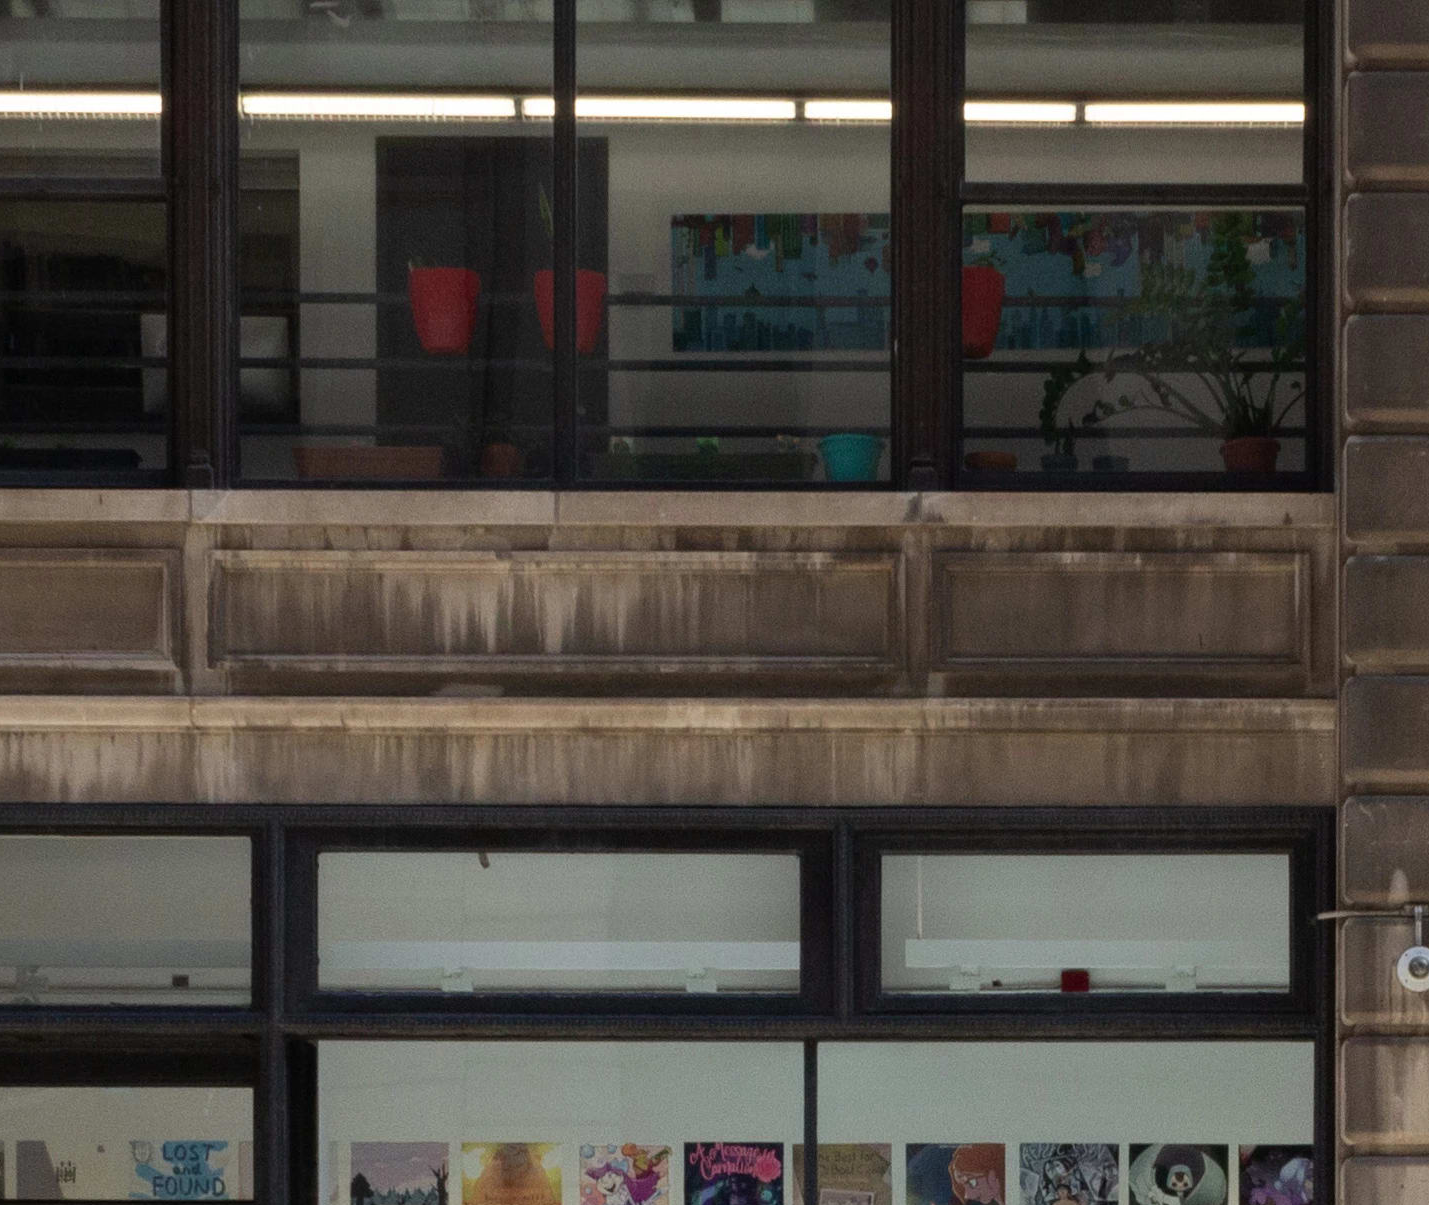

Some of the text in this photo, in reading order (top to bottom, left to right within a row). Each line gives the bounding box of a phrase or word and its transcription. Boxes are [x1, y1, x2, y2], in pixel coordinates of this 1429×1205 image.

[162, 1143, 213, 1161] LOST
[173, 1163, 202, 1175] and
[153, 1176, 226, 1197] FOUND
